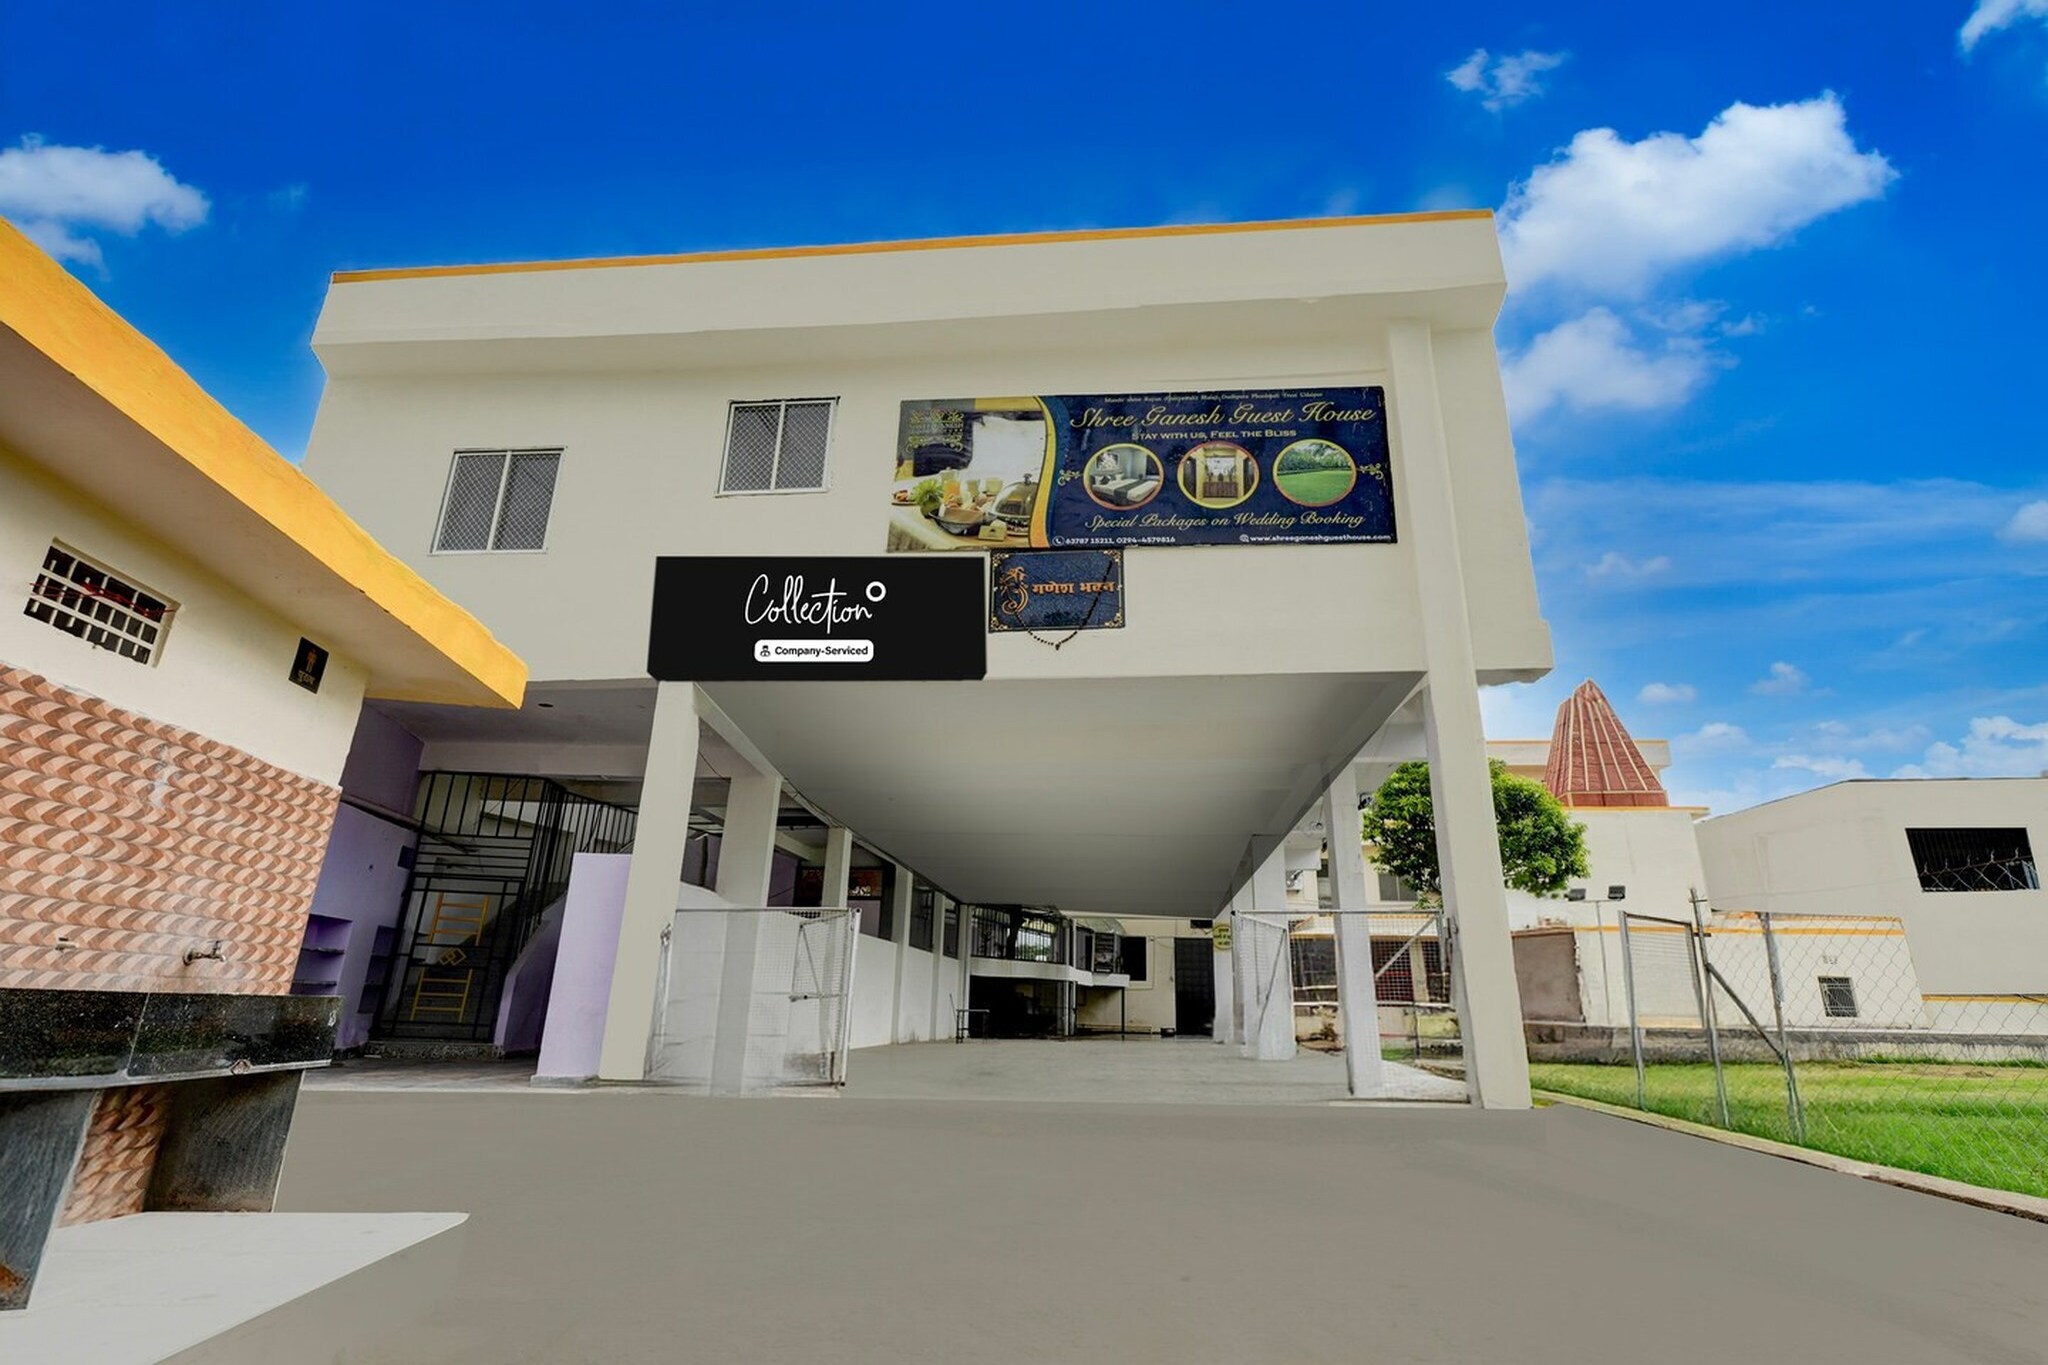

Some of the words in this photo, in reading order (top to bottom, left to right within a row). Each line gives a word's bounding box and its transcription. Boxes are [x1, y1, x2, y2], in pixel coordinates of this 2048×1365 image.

[1070, 407, 1137, 428] Shree
[1141, 404, 1225, 427] Ganesh
[1228, 402, 1295, 425] Guest
[1298, 401, 1376, 423] House
[1131, 432, 1158, 441] STAY
[1158, 431, 1188, 440] WITH
[1210, 430, 1240, 439] FEEL
[1240, 430, 1263, 439] THE
[1264, 428, 1297, 438] BLISS
[1084, 514, 1139, 533] Special
[1139, 512, 1208, 531] Packages
[1210, 517, 1231, 527] on
[1233, 511, 1297, 530] Wedding
[1300, 510, 1366, 528] Booking
[744, 573, 873, 634] Collection
[774, 645, 869, 657] Company-Serviced
